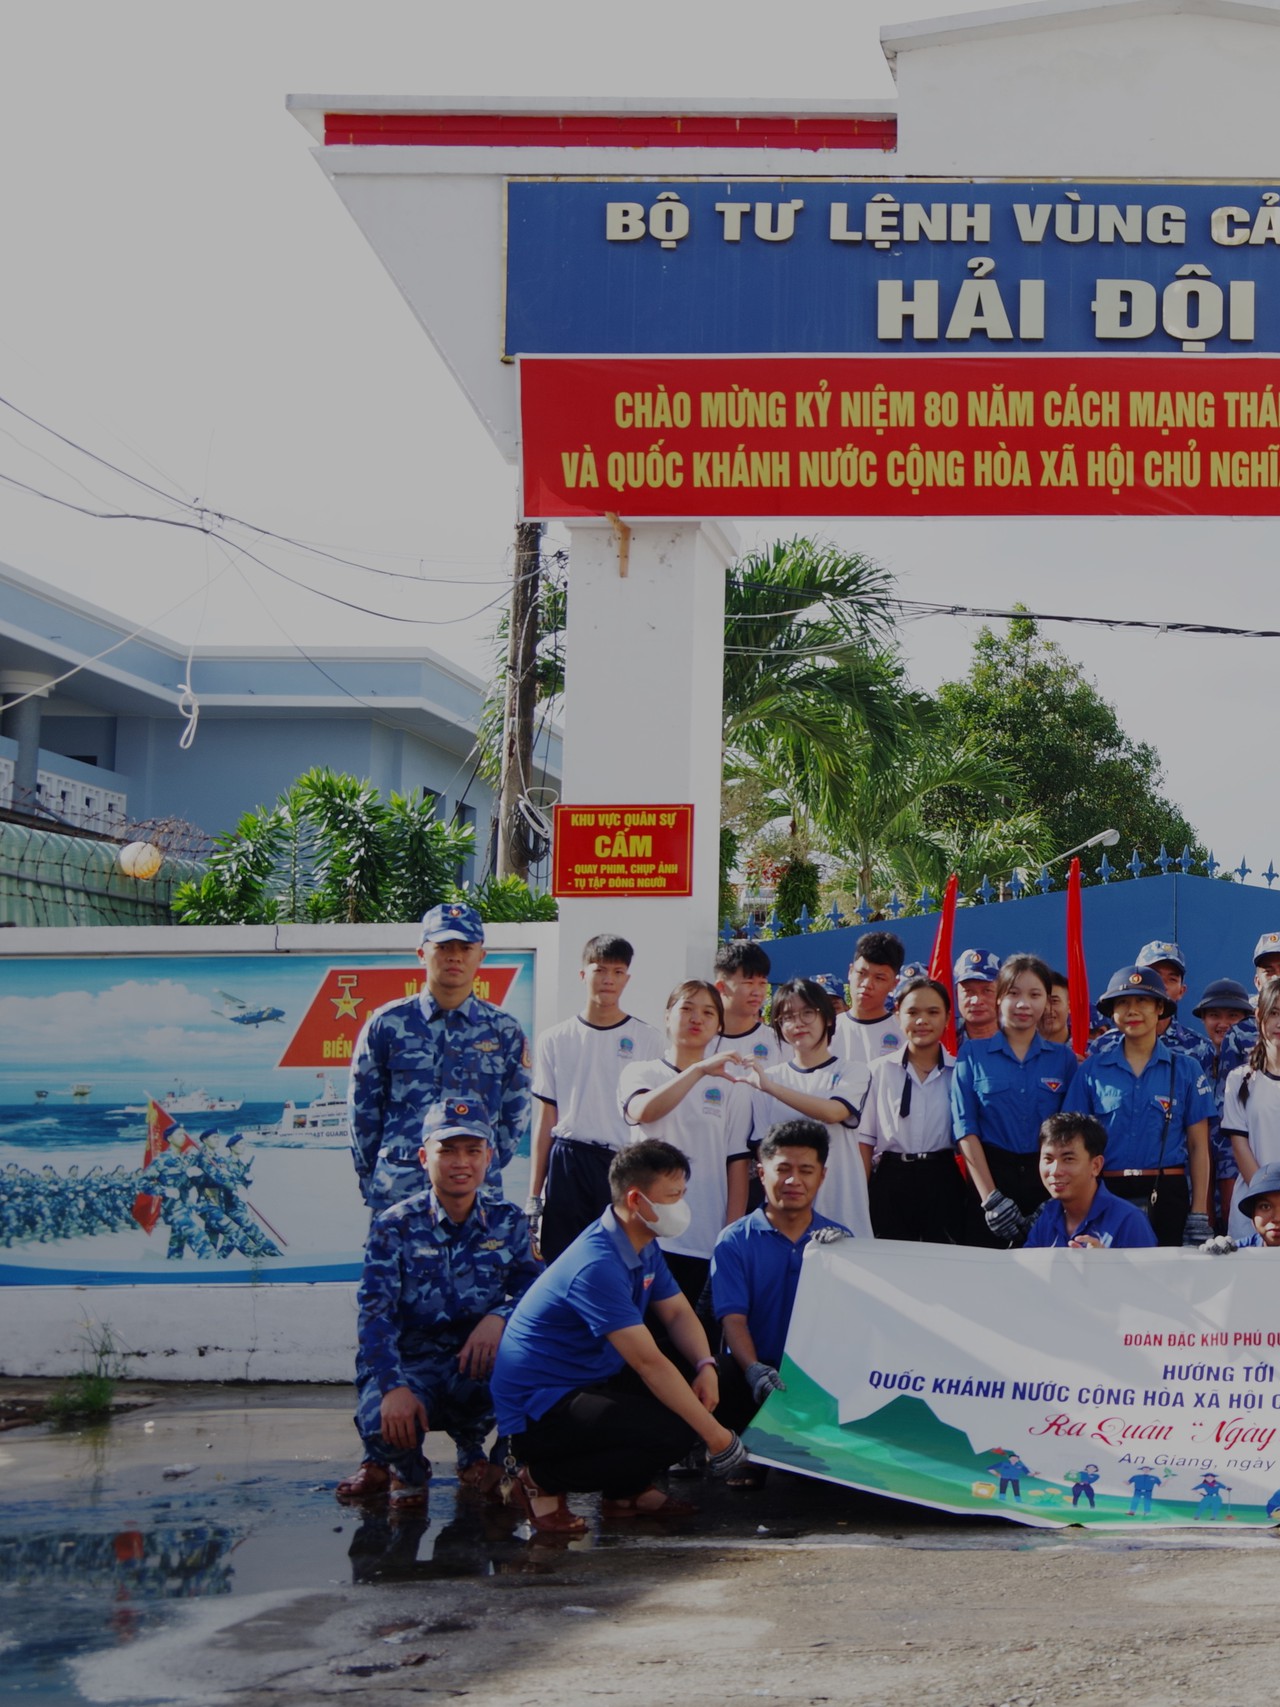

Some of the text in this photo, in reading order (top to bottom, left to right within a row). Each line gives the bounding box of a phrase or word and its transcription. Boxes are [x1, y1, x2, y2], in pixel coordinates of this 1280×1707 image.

[607, 192, 689, 247] BỘ
[716, 199, 803, 240] TƯ
[830, 194, 990, 248] LỆNH
[1013, 193, 1186, 243] VÙNG
[878, 257, 1044, 338] HẢI
[1092, 264, 1254, 351] ĐỘI
[615, 384, 691, 428] CHÀO
[701, 384, 786, 428] MỪNG
[796, 380, 831, 427] KỶ
[841, 384, 915, 435] NIỆM
[924, 391, 958, 427] 80
[968, 384, 1034, 426] NĂM
[1044, 384, 1119, 427] CÁCH
[1130, 392, 1215, 435] MẠNG
[561, 445, 599, 487] VÀ
[608, 439, 683, 491] QUỐC
[693, 444, 790, 487] KHÁNH
[800, 444, 877, 487] NƯỚC
[887, 443, 964, 494] CỘNG
[974, 442, 1031, 487] HÒA
[1040, 444, 1078, 486] XÃ
[1088, 443, 1134, 494] HỘI
[1144, 439, 1200, 487] CHỦ
[571, 811, 677, 828] KHU VỰC QUÂN SỰ
[595, 828, 652, 857] CẤM
[1124, 1331, 1163, 1346] ĐOÀN
[1167, 1331, 1196, 1350] ĐẶC
[1200, 1332, 1228, 1346] KHU
[1233, 1329, 1262, 1346] PHÚ
[1163, 1362, 1234, 1381] HƯỚNG
[1243, 1361, 1274, 1382] TỚI
[869, 1369, 925, 1391] QUỐC
[932, 1376, 1006, 1399] KHÁNH
[1012, 1381, 1070, 1402] NƯỚC
[1078, 1385, 1135, 1408] CỘNG
[1143, 1387, 1184, 1407] HÒA
[1193, 1389, 1220, 1408] XÃ
[1229, 1391, 1263, 1413] HỘI
[1118, 1454, 1145, 1464] An
[1152, 1455, 1216, 1470] Giang,
[1227, 1457, 1275, 1471] ngày
